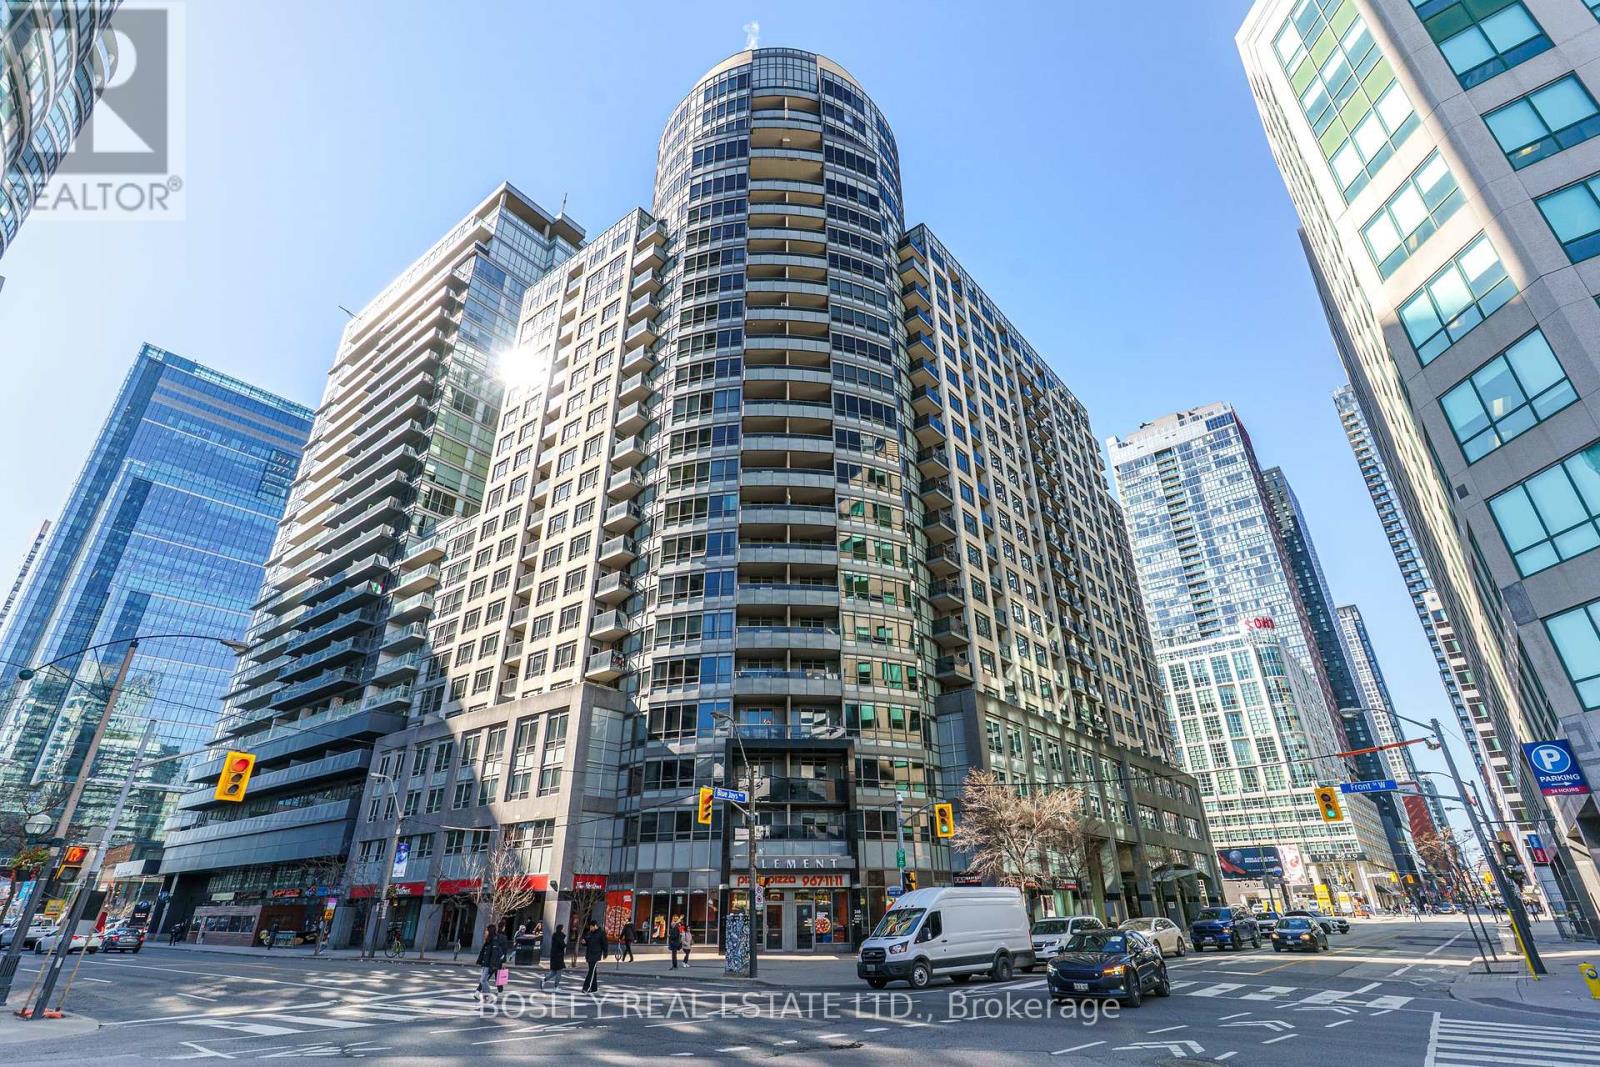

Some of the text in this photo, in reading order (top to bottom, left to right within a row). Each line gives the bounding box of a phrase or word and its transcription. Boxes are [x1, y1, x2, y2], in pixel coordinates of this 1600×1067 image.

[1539, 749, 1560, 769] P
[1539, 773, 1580, 782] PARKING
[1350, 782, 1372, 791] Front
[1377, 781, 1386, 789] W
[761, 859, 837, 868] LEMENT
[768, 875, 796, 886] pizza
